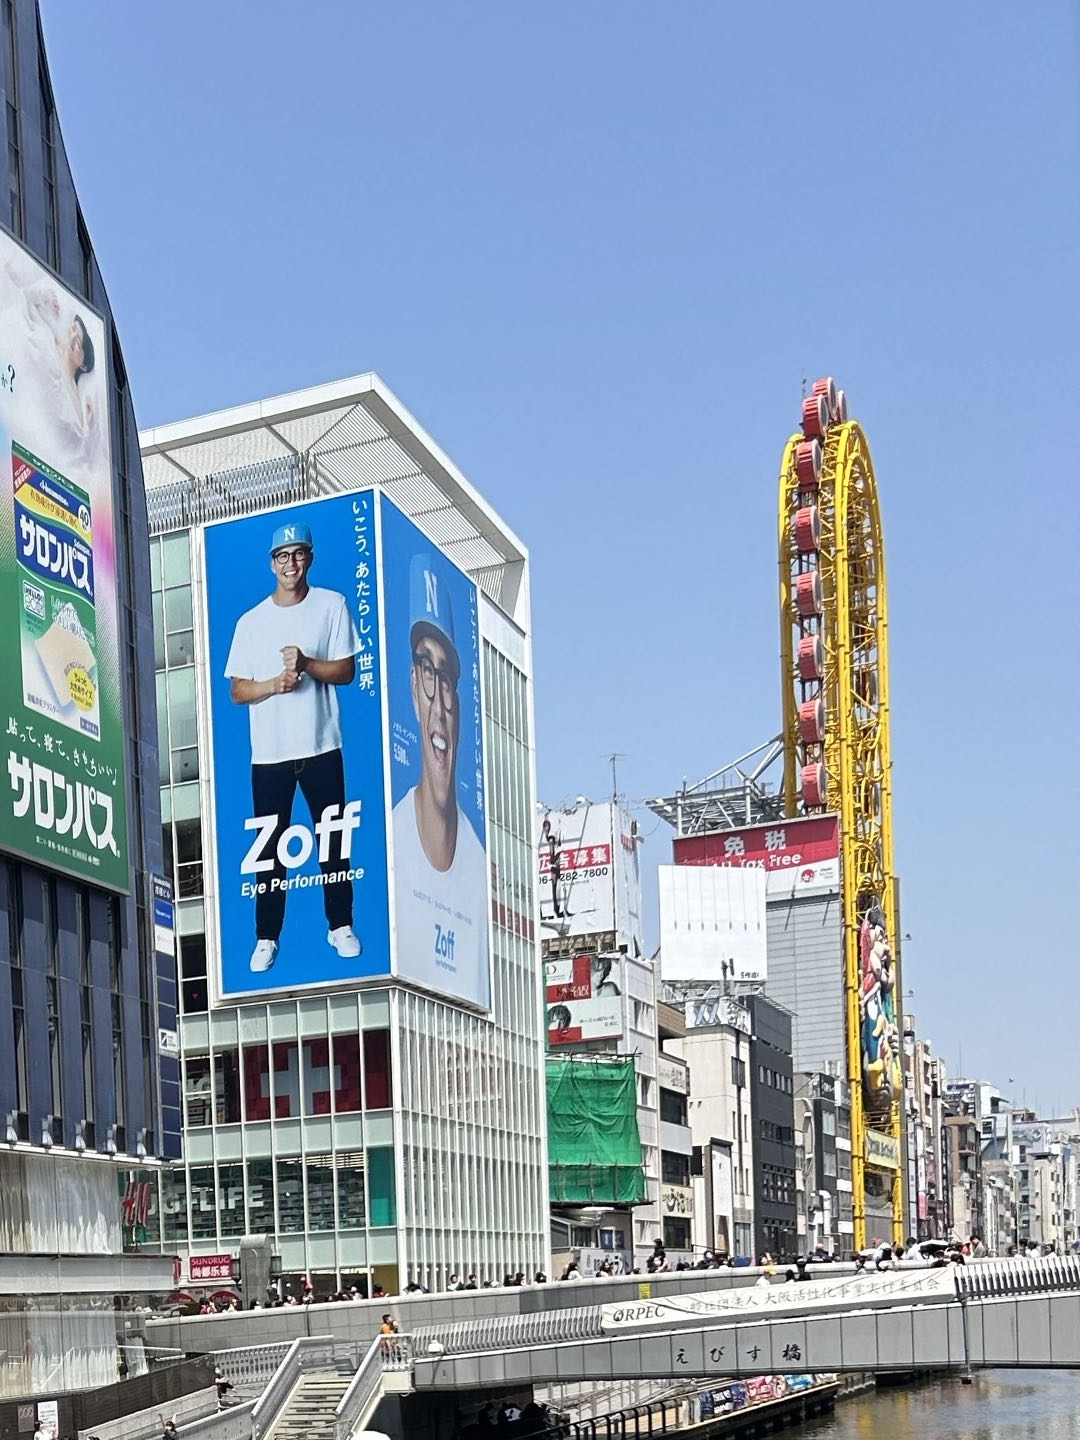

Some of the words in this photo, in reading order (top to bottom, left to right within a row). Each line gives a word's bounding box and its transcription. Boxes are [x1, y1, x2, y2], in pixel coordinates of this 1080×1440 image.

[283, 527, 296, 541] N
[20, 514, 91, 596] サロンパス
[352, 501, 376, 698] いこう、あたらしい世界。
[423, 569, 439, 618] N
[8, 750, 118, 856] サロンパス
[240, 800, 361, 875] Zoff
[770, 852, 802, 867] Free
[240, 879, 267, 899] Eye
[270, 866, 365, 894] Performance
[435, 923, 455, 960] Zoff
[191, 1255, 230, 1266] SUNDRUG
[675, 1344, 802, 1364] えびす橋
